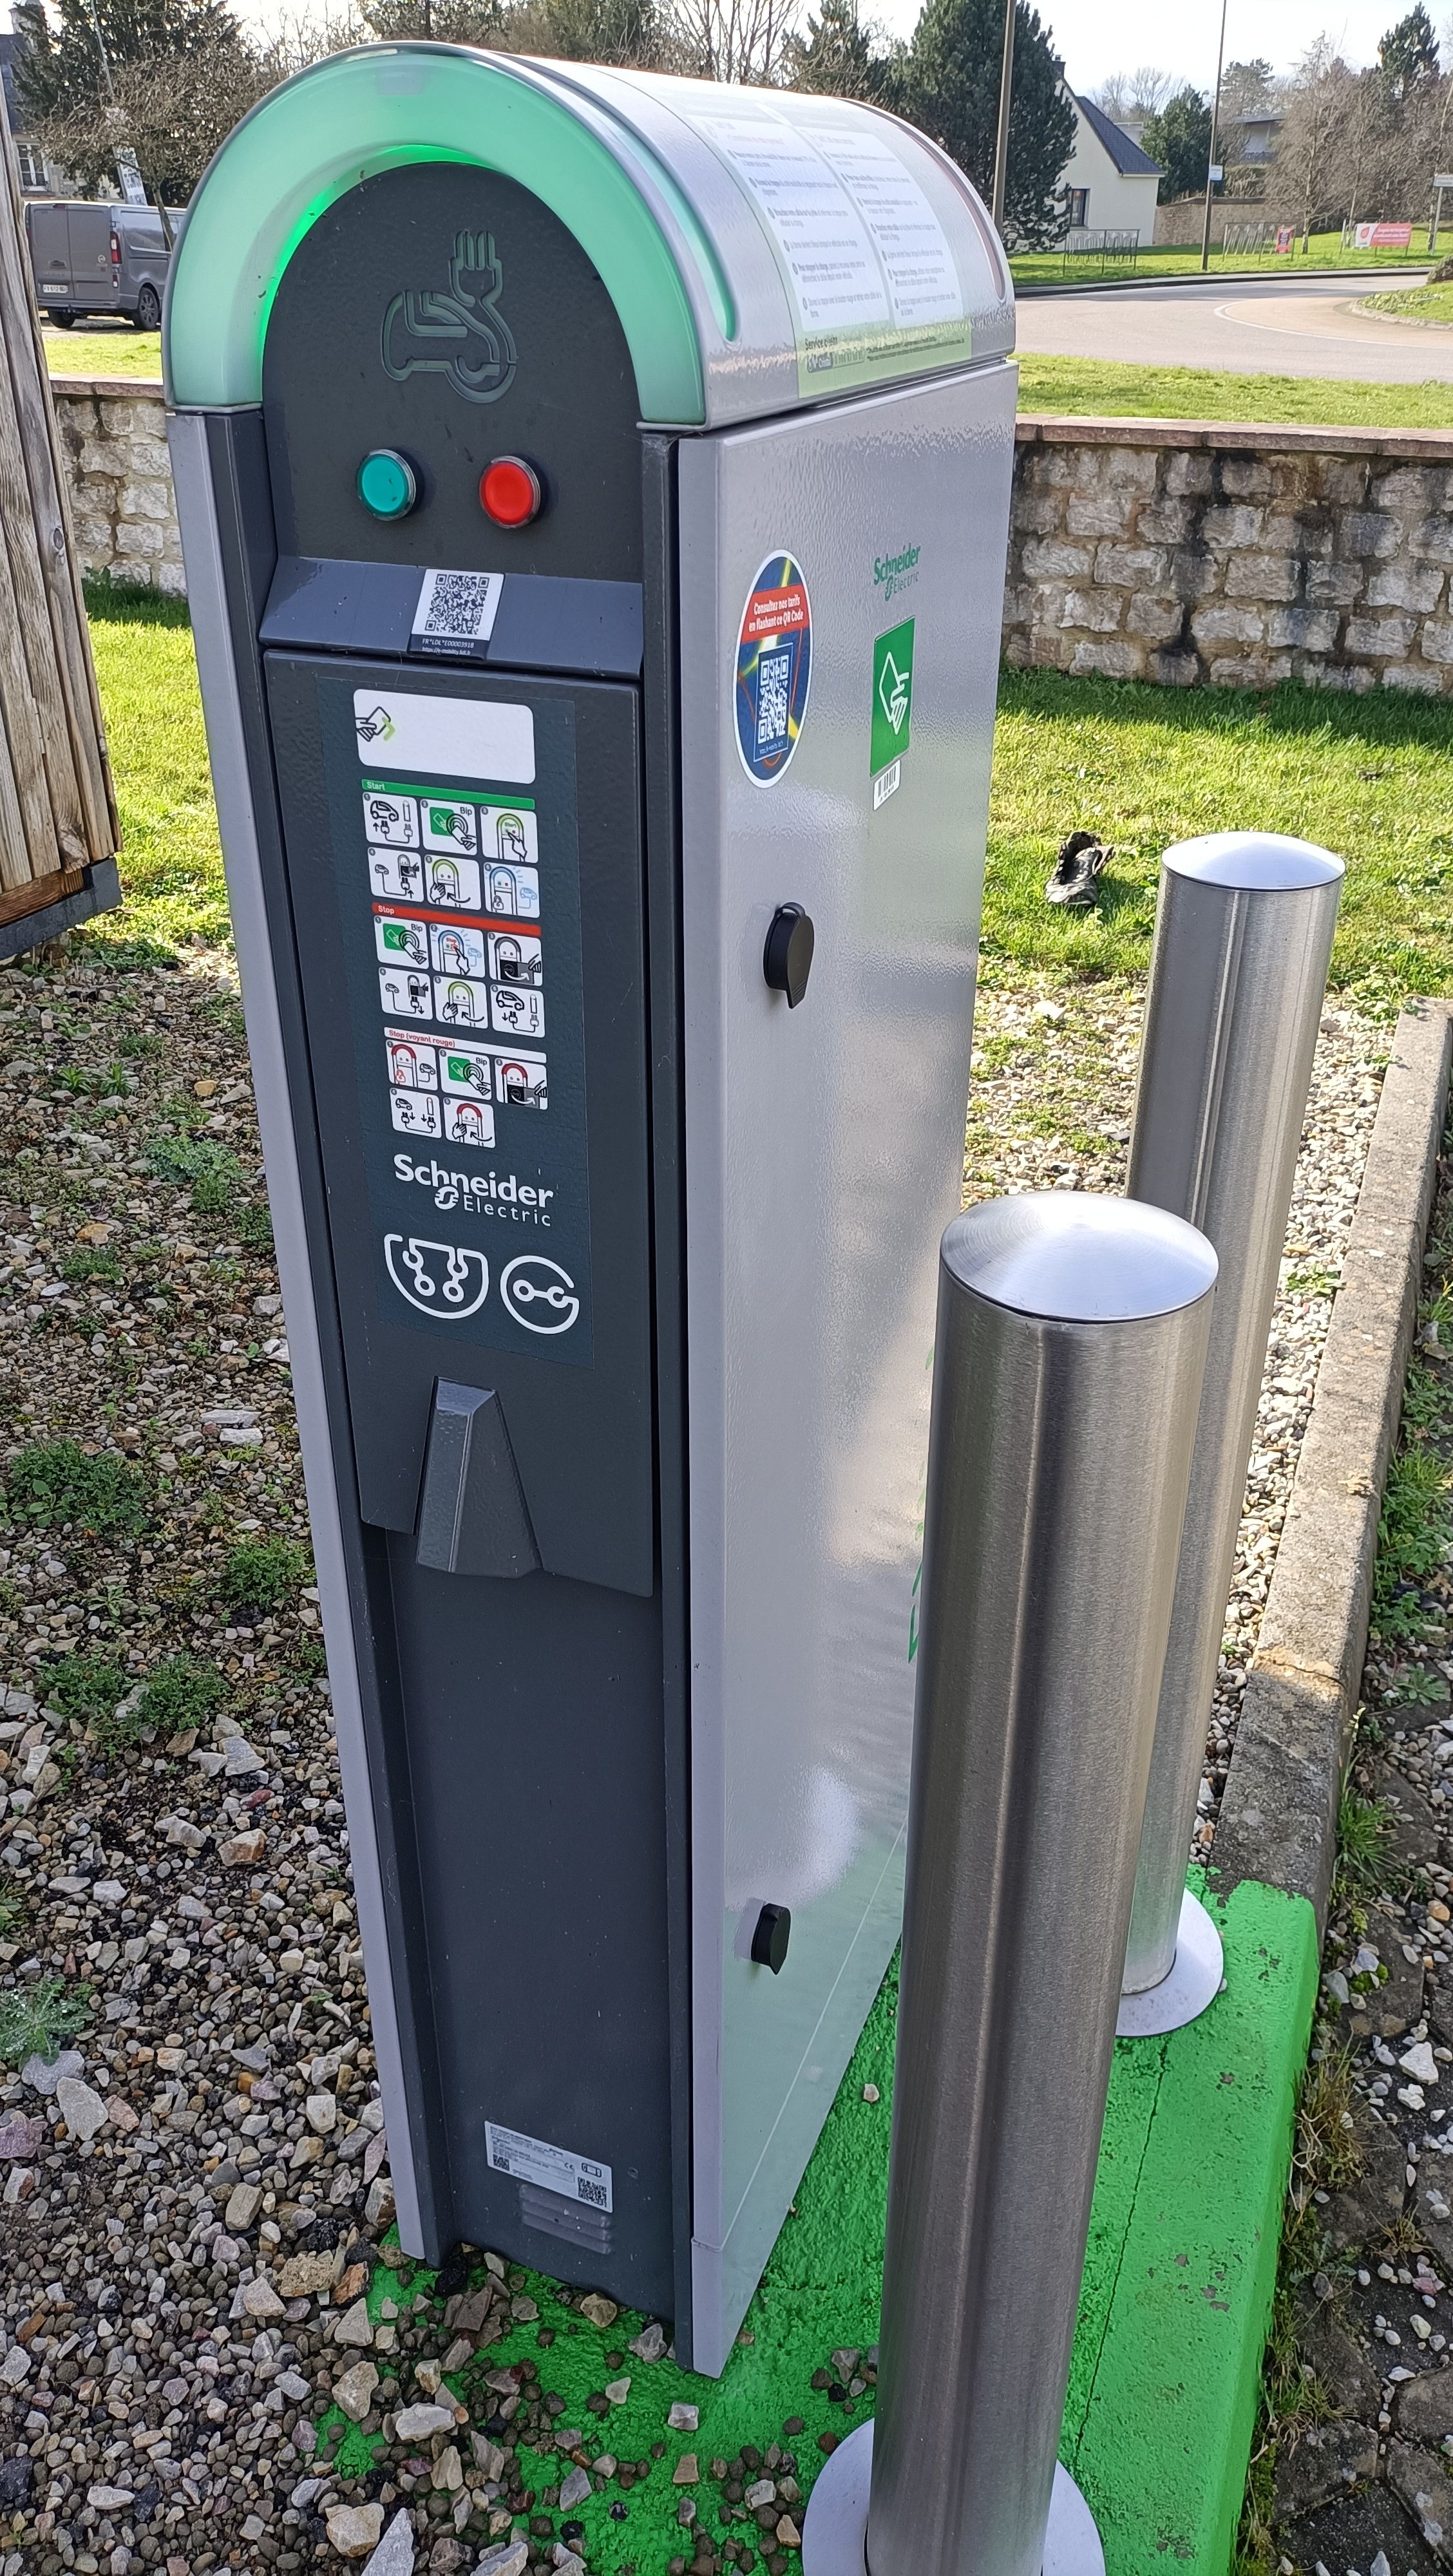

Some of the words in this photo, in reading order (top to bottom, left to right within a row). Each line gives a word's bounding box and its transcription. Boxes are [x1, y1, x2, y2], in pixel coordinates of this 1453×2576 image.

[874, 542, 921, 585] Schneider
[893, 571, 919, 594] Electric
[754, 600, 778, 615] Consultez
[779, 600, 787, 610] nos
[788, 594, 801, 608] tarifs
[748, 622, 756, 632] en
[756, 616, 776, 630] flashant
[777, 616, 783, 625] ce
[783, 611, 791, 627] QR
[791, 609, 804, 622] Code
[366, 781, 386, 791] Start
[460, 807, 473, 816] Bip
[378, 905, 395, 915] Stop
[411, 923, 423, 933] Bip
[388, 1030, 404, 1040] Stop
[406, 1032, 432, 1045] (voyant
[433, 1038, 455, 1048] rouge)
[476, 1057, 488, 1066] Bip
[394, 1153, 554, 1208] Schneider
[464, 1194, 551, 1227] Electric
